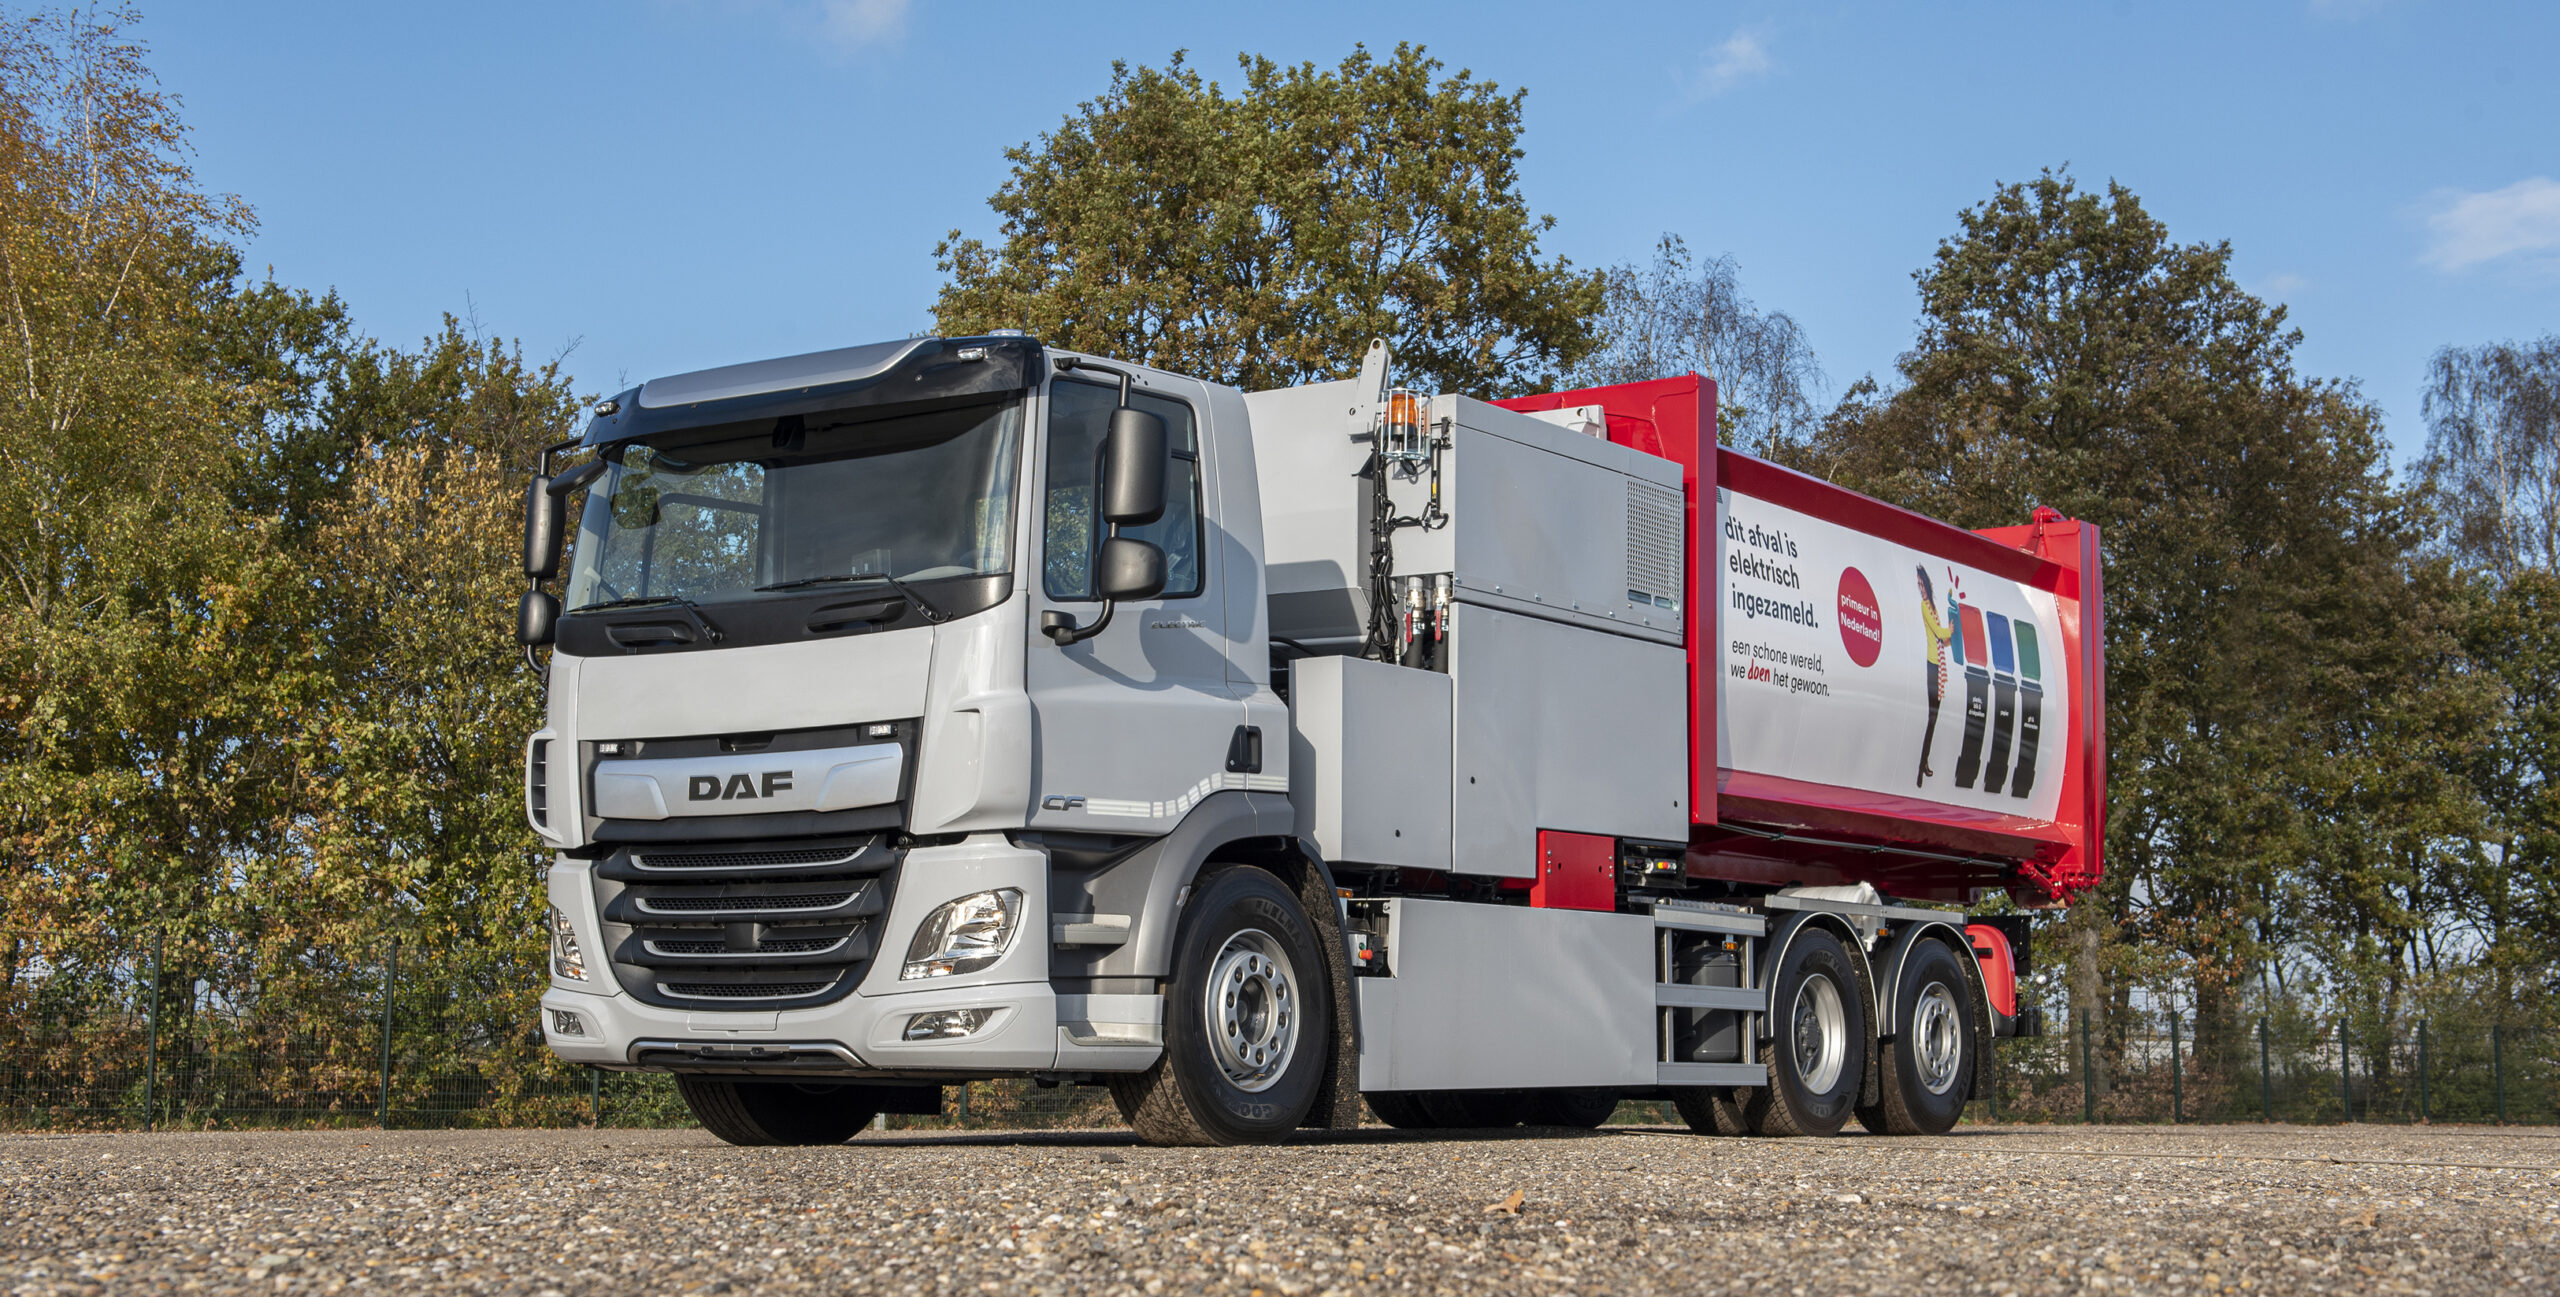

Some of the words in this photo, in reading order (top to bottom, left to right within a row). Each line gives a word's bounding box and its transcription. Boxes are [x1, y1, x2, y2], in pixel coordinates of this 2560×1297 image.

[1725, 515, 1746, 544] dit
[1748, 524, 1783, 554] afval
[1784, 532, 1798, 558] is
[1729, 549, 1800, 590] elektrisch
[1732, 582, 1819, 628] ingezameld.
[1841, 594, 1870, 616] primeur
[1870, 605, 1878, 621] in
[1841, 611, 1880, 642] Nederland!
[1732, 640, 1751, 656] een
[1753, 642, 1788, 665] schone
[1790, 653, 1824, 676] wereld,
[1730, 663, 1746, 679] we
[1747, 658, 1771, 683] doen
[1773, 668, 1789, 688] het
[1790, 676, 1830, 697] gewoon.
[688, 770, 795, 801] DAF
[1042, 794, 1086, 811] CF
